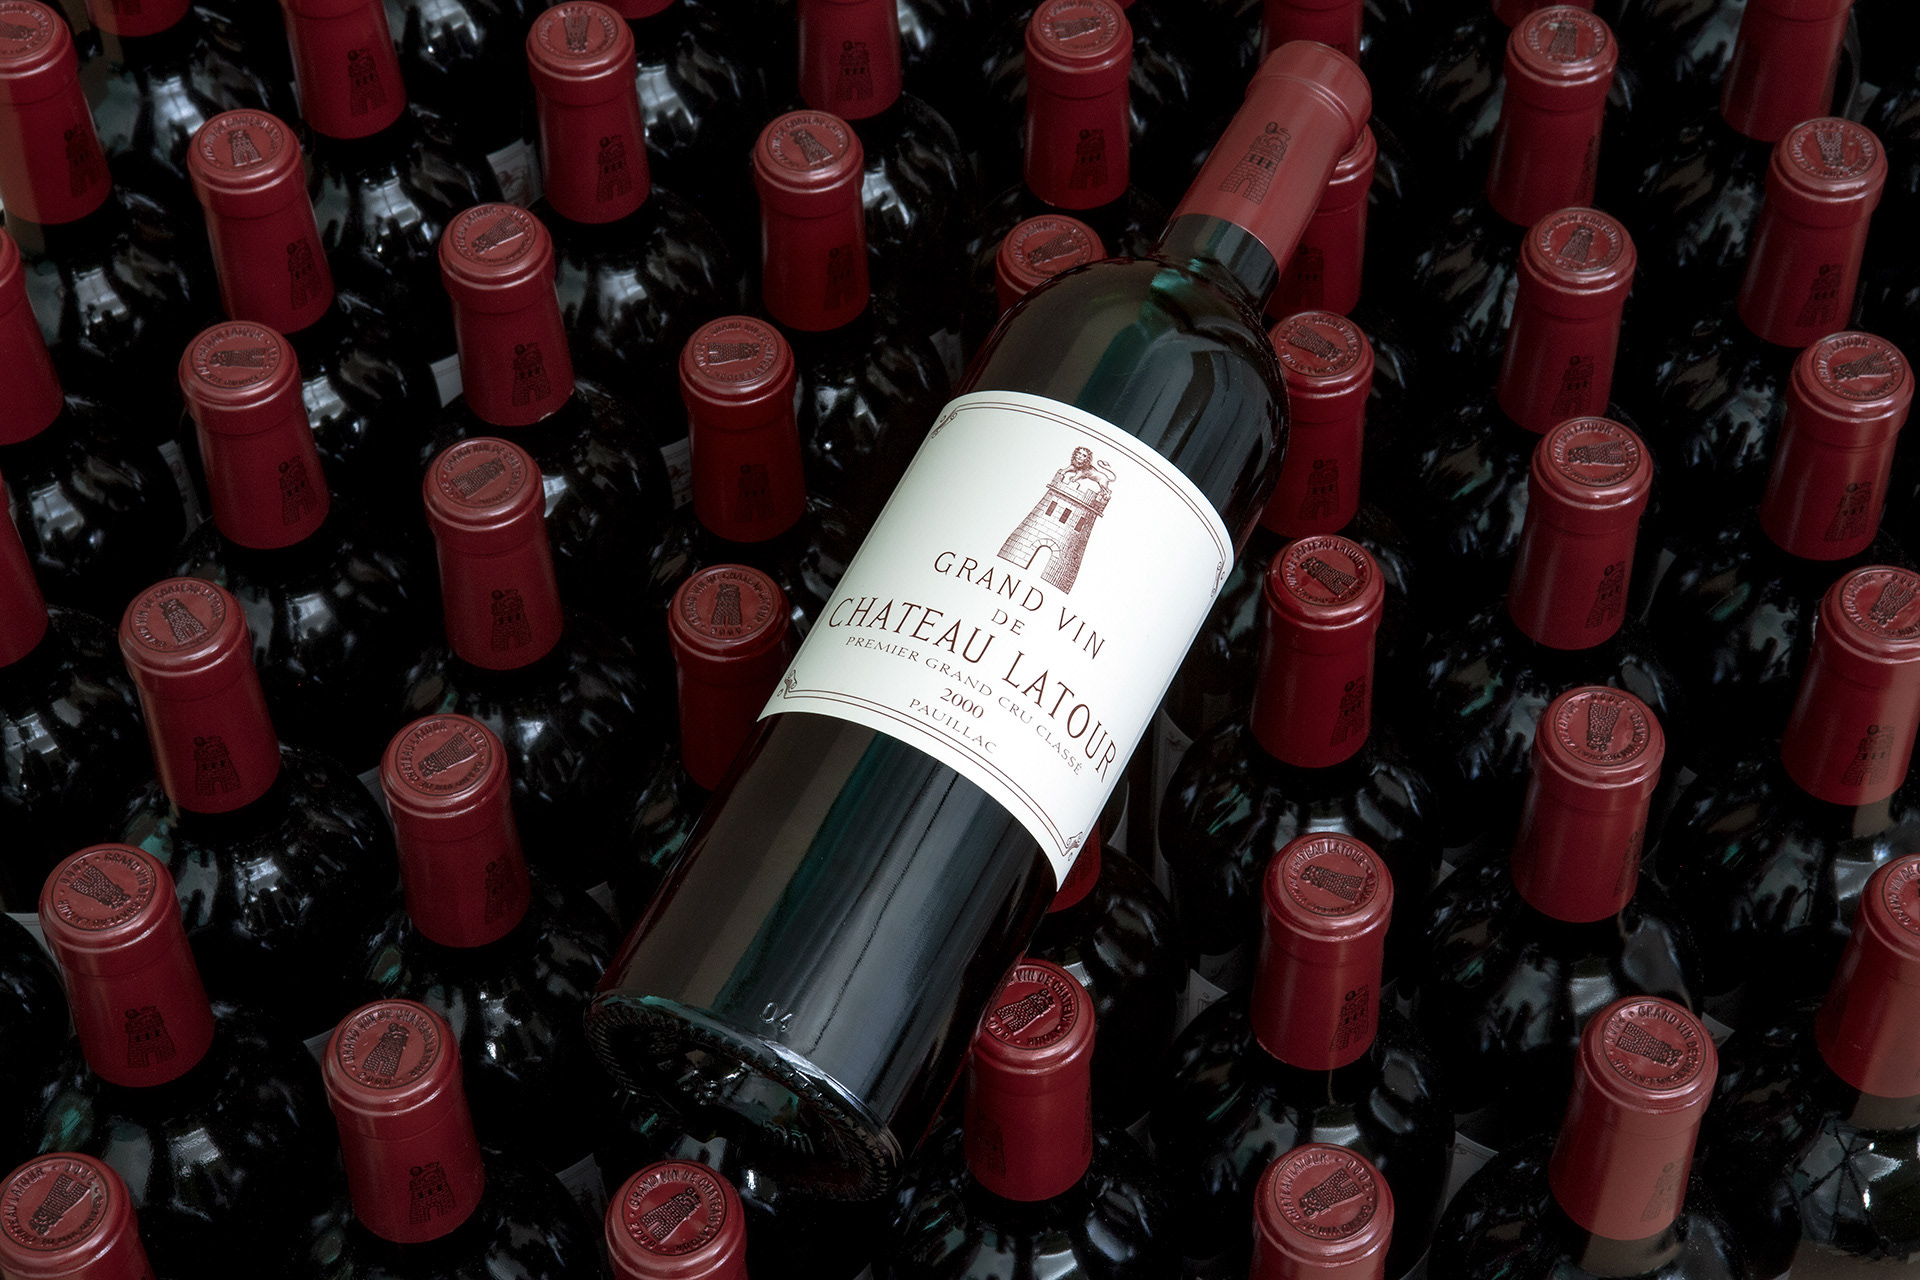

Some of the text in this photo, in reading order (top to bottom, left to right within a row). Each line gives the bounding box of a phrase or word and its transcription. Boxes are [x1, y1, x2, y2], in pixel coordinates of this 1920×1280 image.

[933, 551, 1106, 660] GRAND VIN
[990, 608, 1025, 636] DE
[828, 596, 1117, 783] CHATEAU LATOUR
[845, 636, 1083, 776] PREMIER GRAND CRU CLASSÉ
[939, 687, 985, 719] 2000
[908, 698, 997, 754] PAUILLAC
[105, 853, 145, 874] GRAND
[1288, 842, 1329, 876] CHATEAU
[1330, 842, 1371, 868] LATOUR
[1635, 1006, 1682, 1026] GRAND
[1677, 1020, 1698, 1040] VIN
[5, 1166, 47, 1204] LATOUR
[628, 1173, 660, 1212] GRAND
[656, 1168, 681, 1183] VIN
